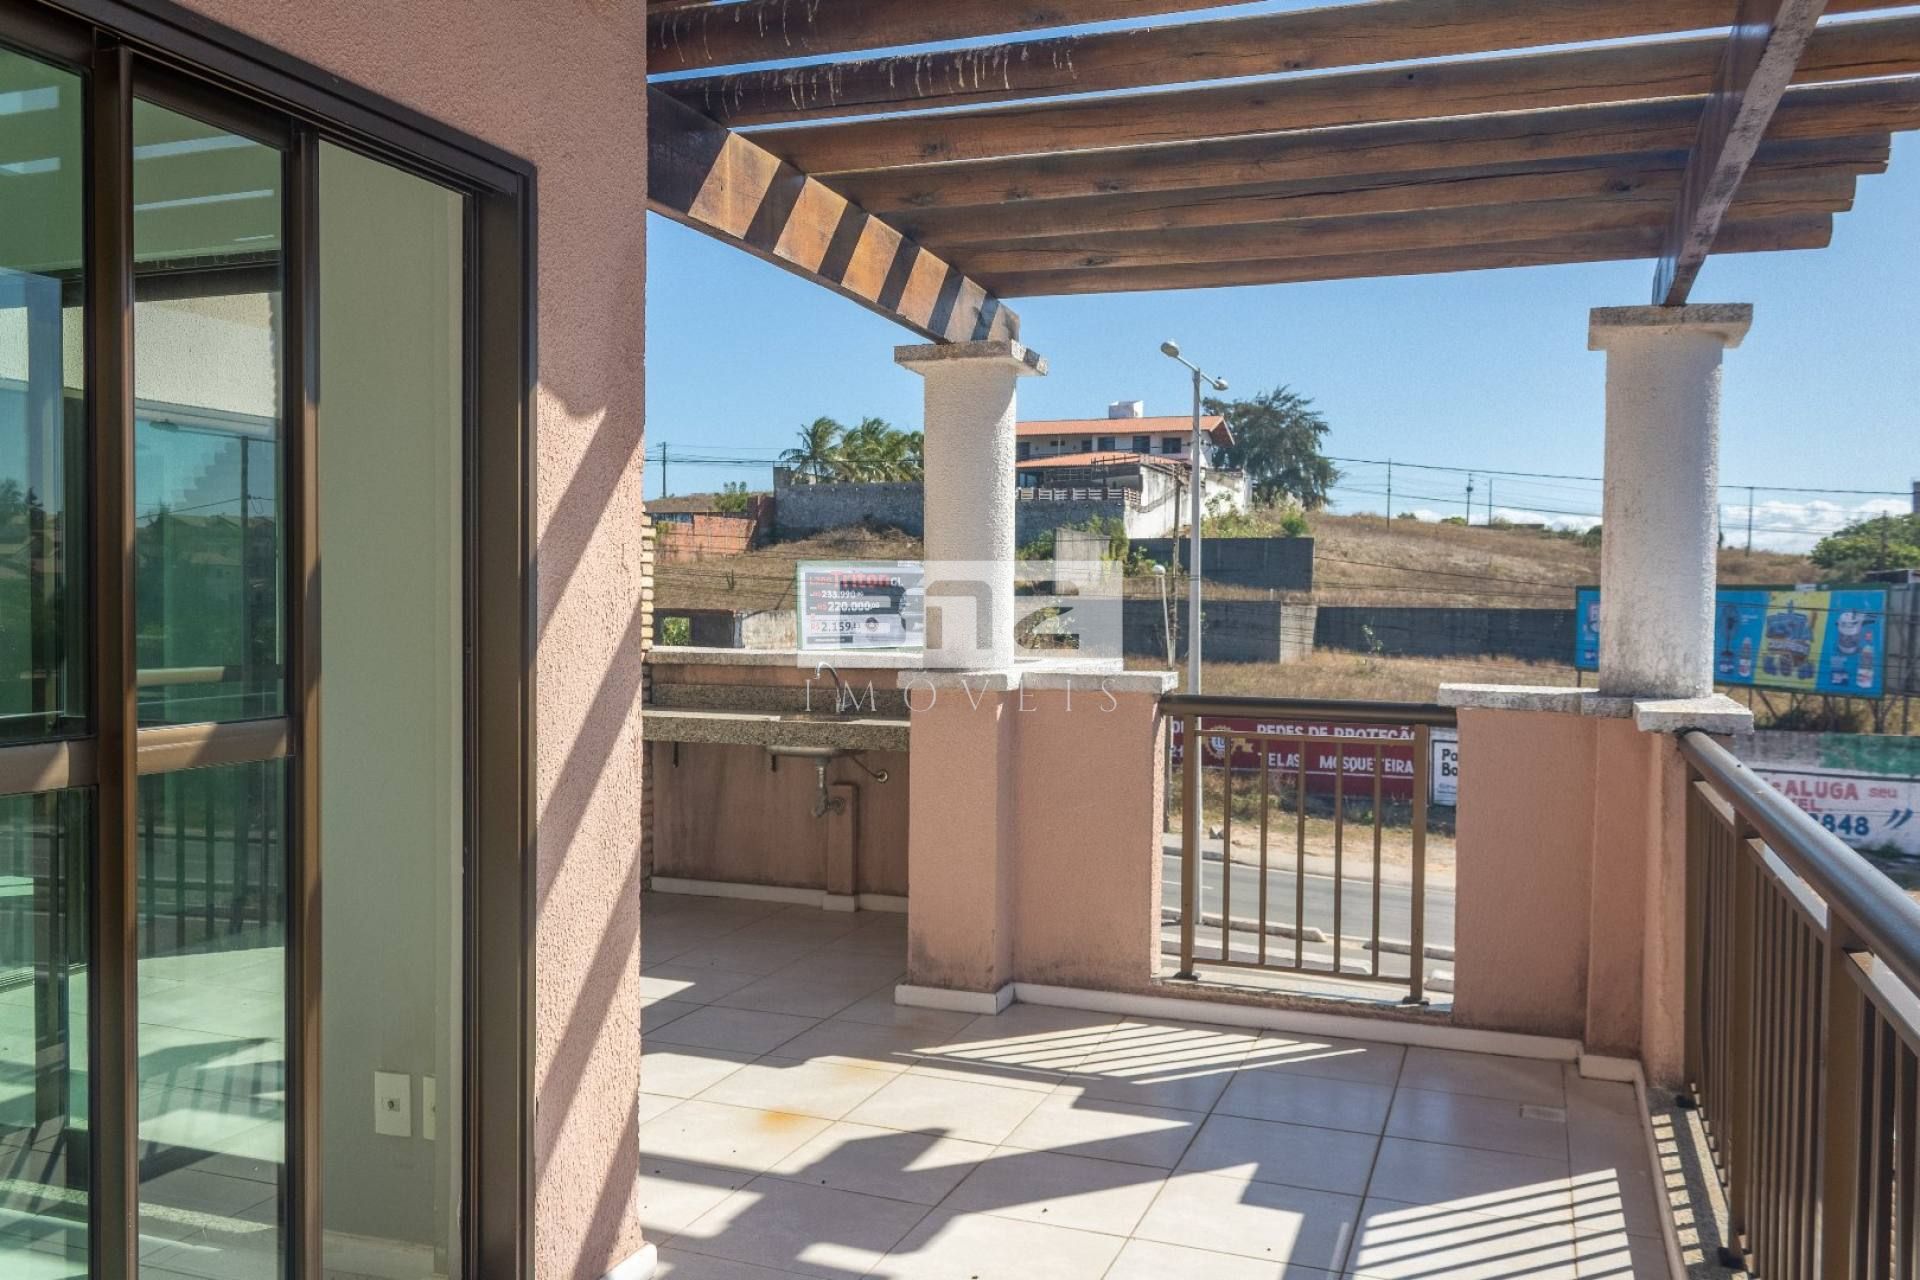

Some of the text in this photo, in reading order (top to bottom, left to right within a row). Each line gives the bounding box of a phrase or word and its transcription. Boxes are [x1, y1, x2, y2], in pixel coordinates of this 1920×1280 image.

[1257, 751, 1415, 774] ELAS MSQUEEIRA
[1784, 779, 1860, 800] ALUGA
[1808, 812, 1870, 836] 848
